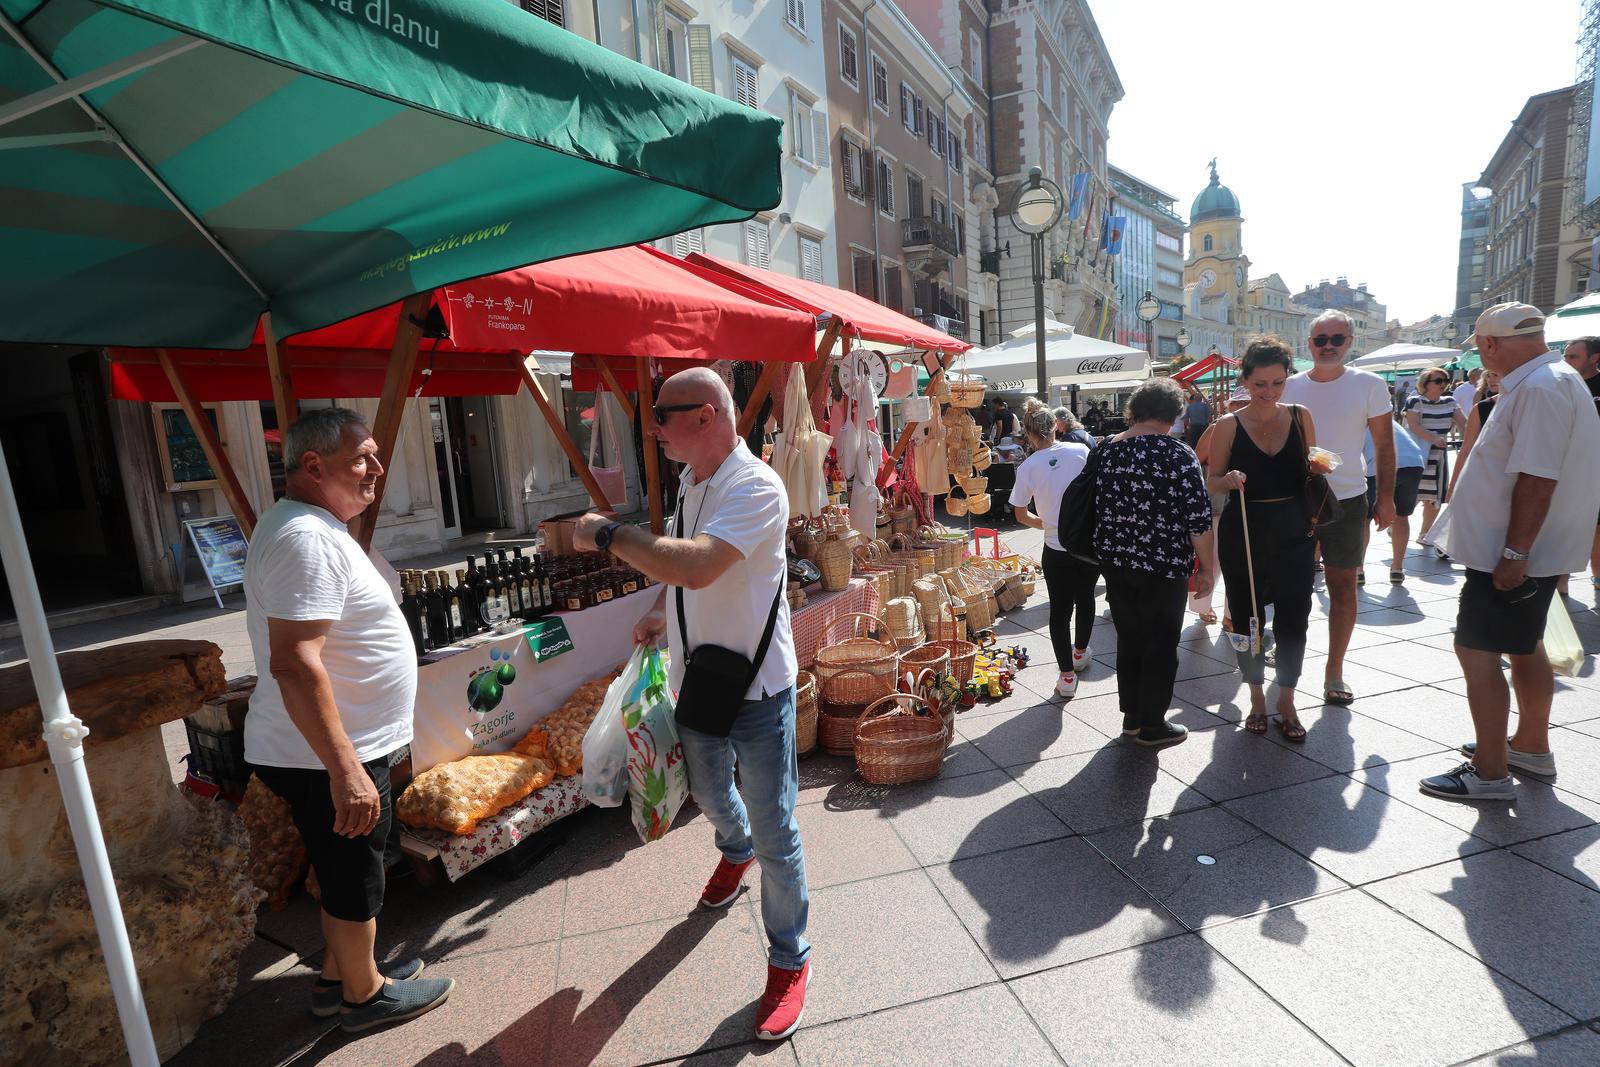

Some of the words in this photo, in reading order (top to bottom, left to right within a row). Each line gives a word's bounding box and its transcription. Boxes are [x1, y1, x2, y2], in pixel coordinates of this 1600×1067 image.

[365, 0, 440, 49] dlanu
[487, 320, 526, 331] Frankopana
[472, 710, 515, 736] Zagorje
